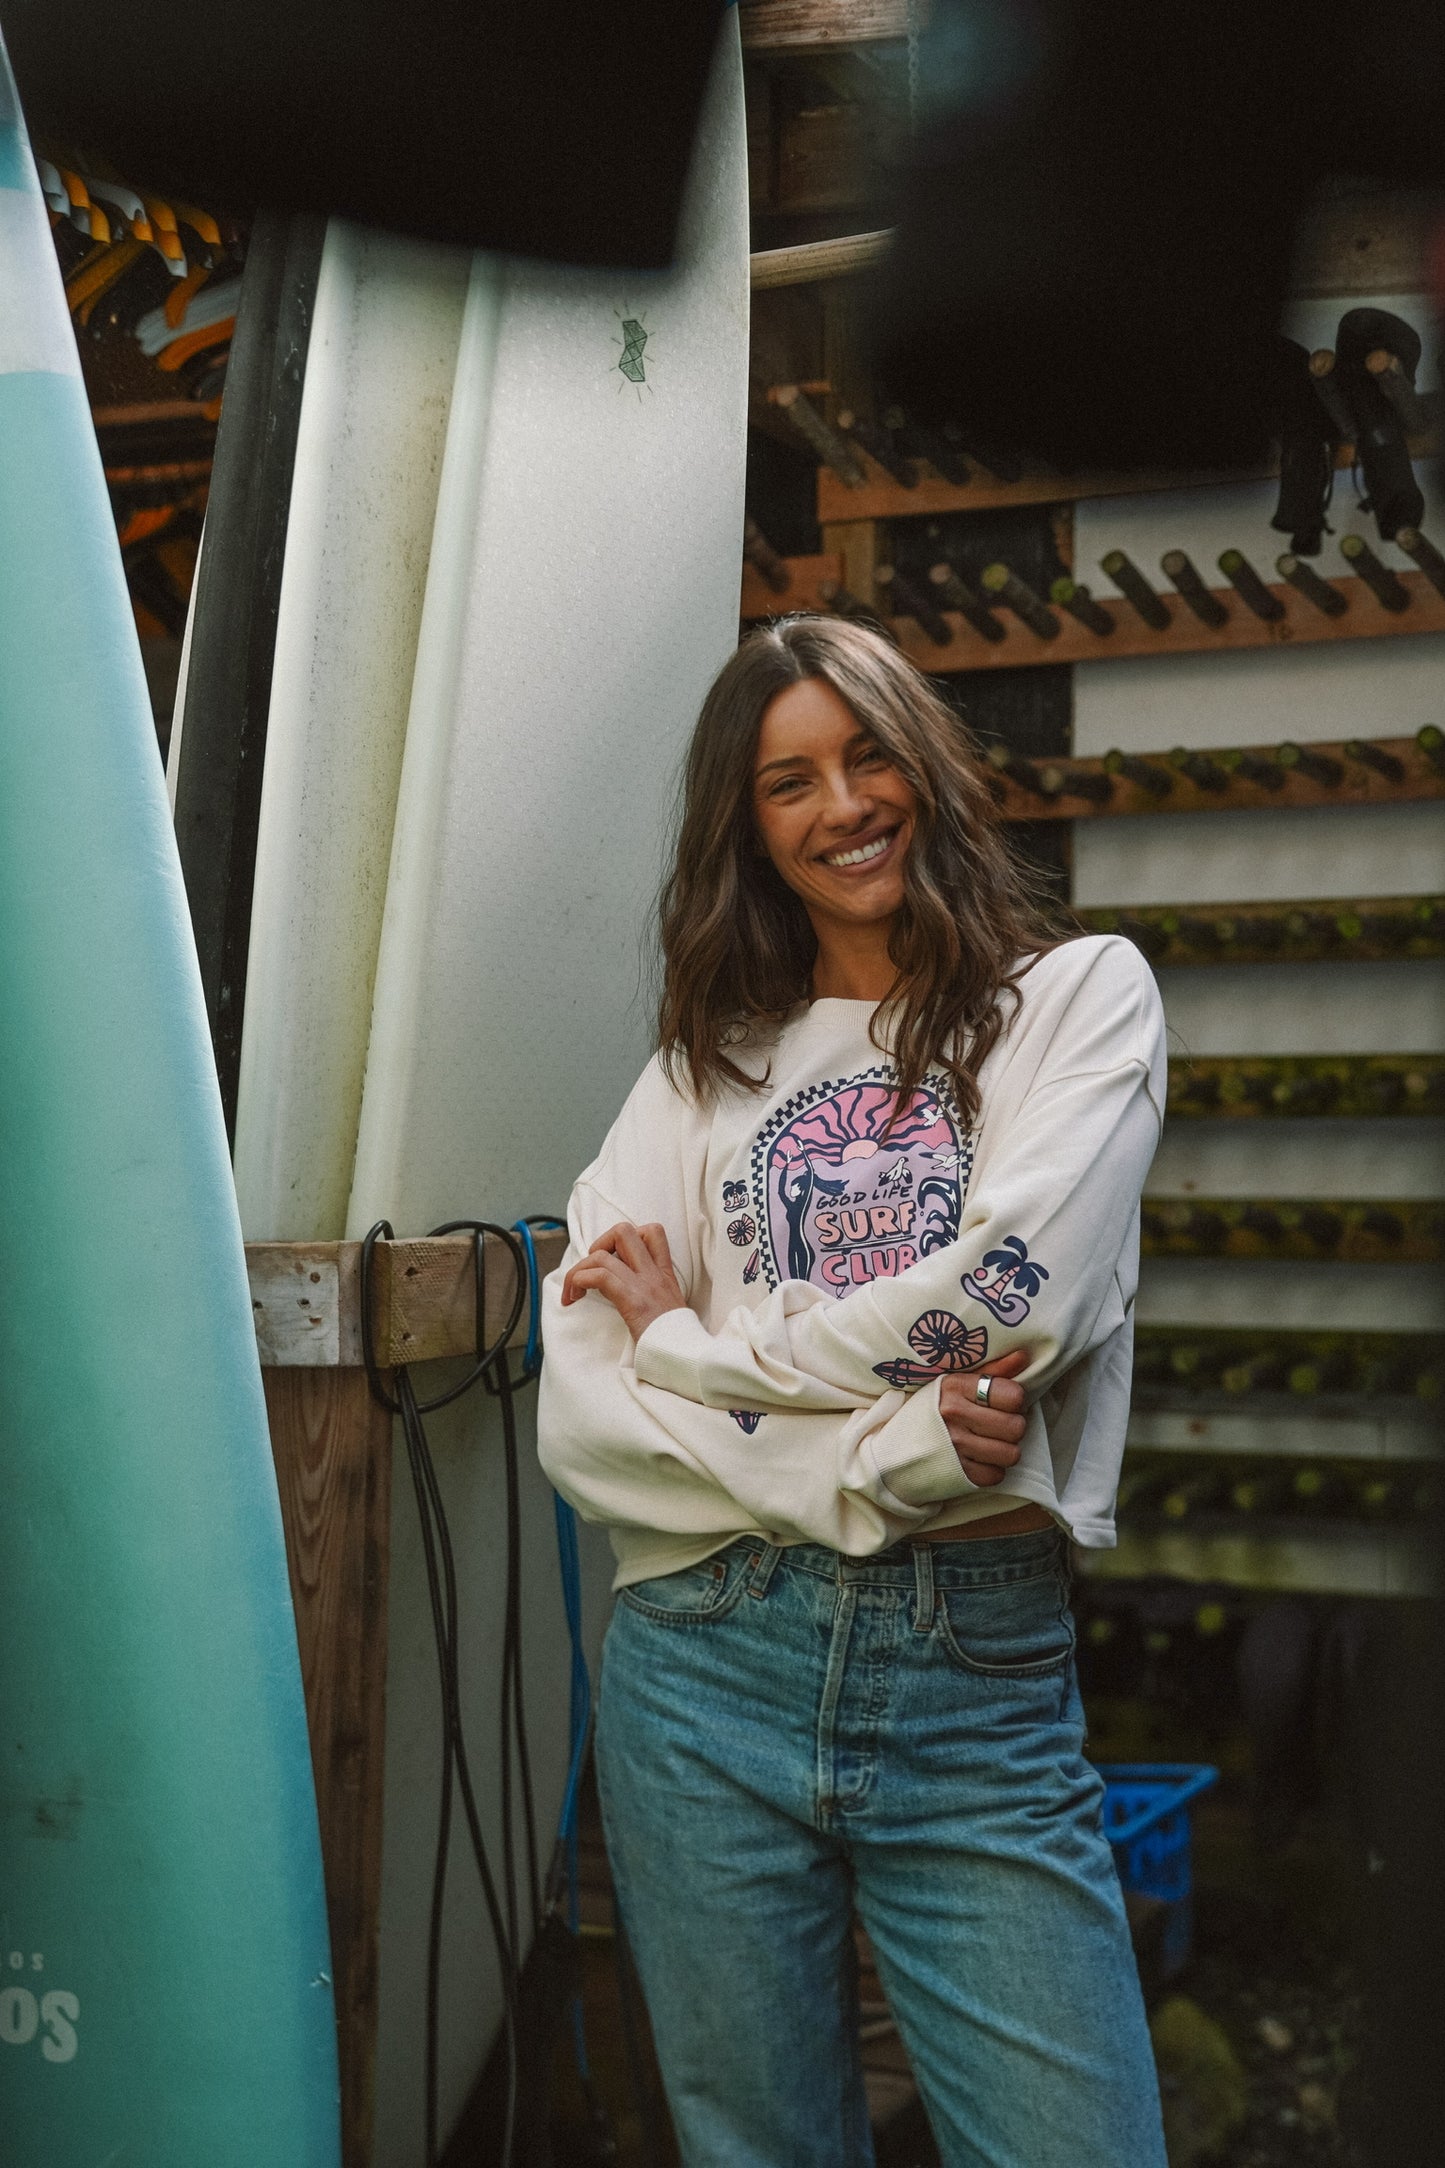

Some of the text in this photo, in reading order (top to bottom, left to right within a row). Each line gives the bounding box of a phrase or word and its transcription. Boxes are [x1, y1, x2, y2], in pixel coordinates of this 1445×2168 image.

[816, 1185, 913, 1210] GOOD LIFE
[814, 1200, 917, 1246] SURF
[821, 1244, 918, 1286] CLUB
